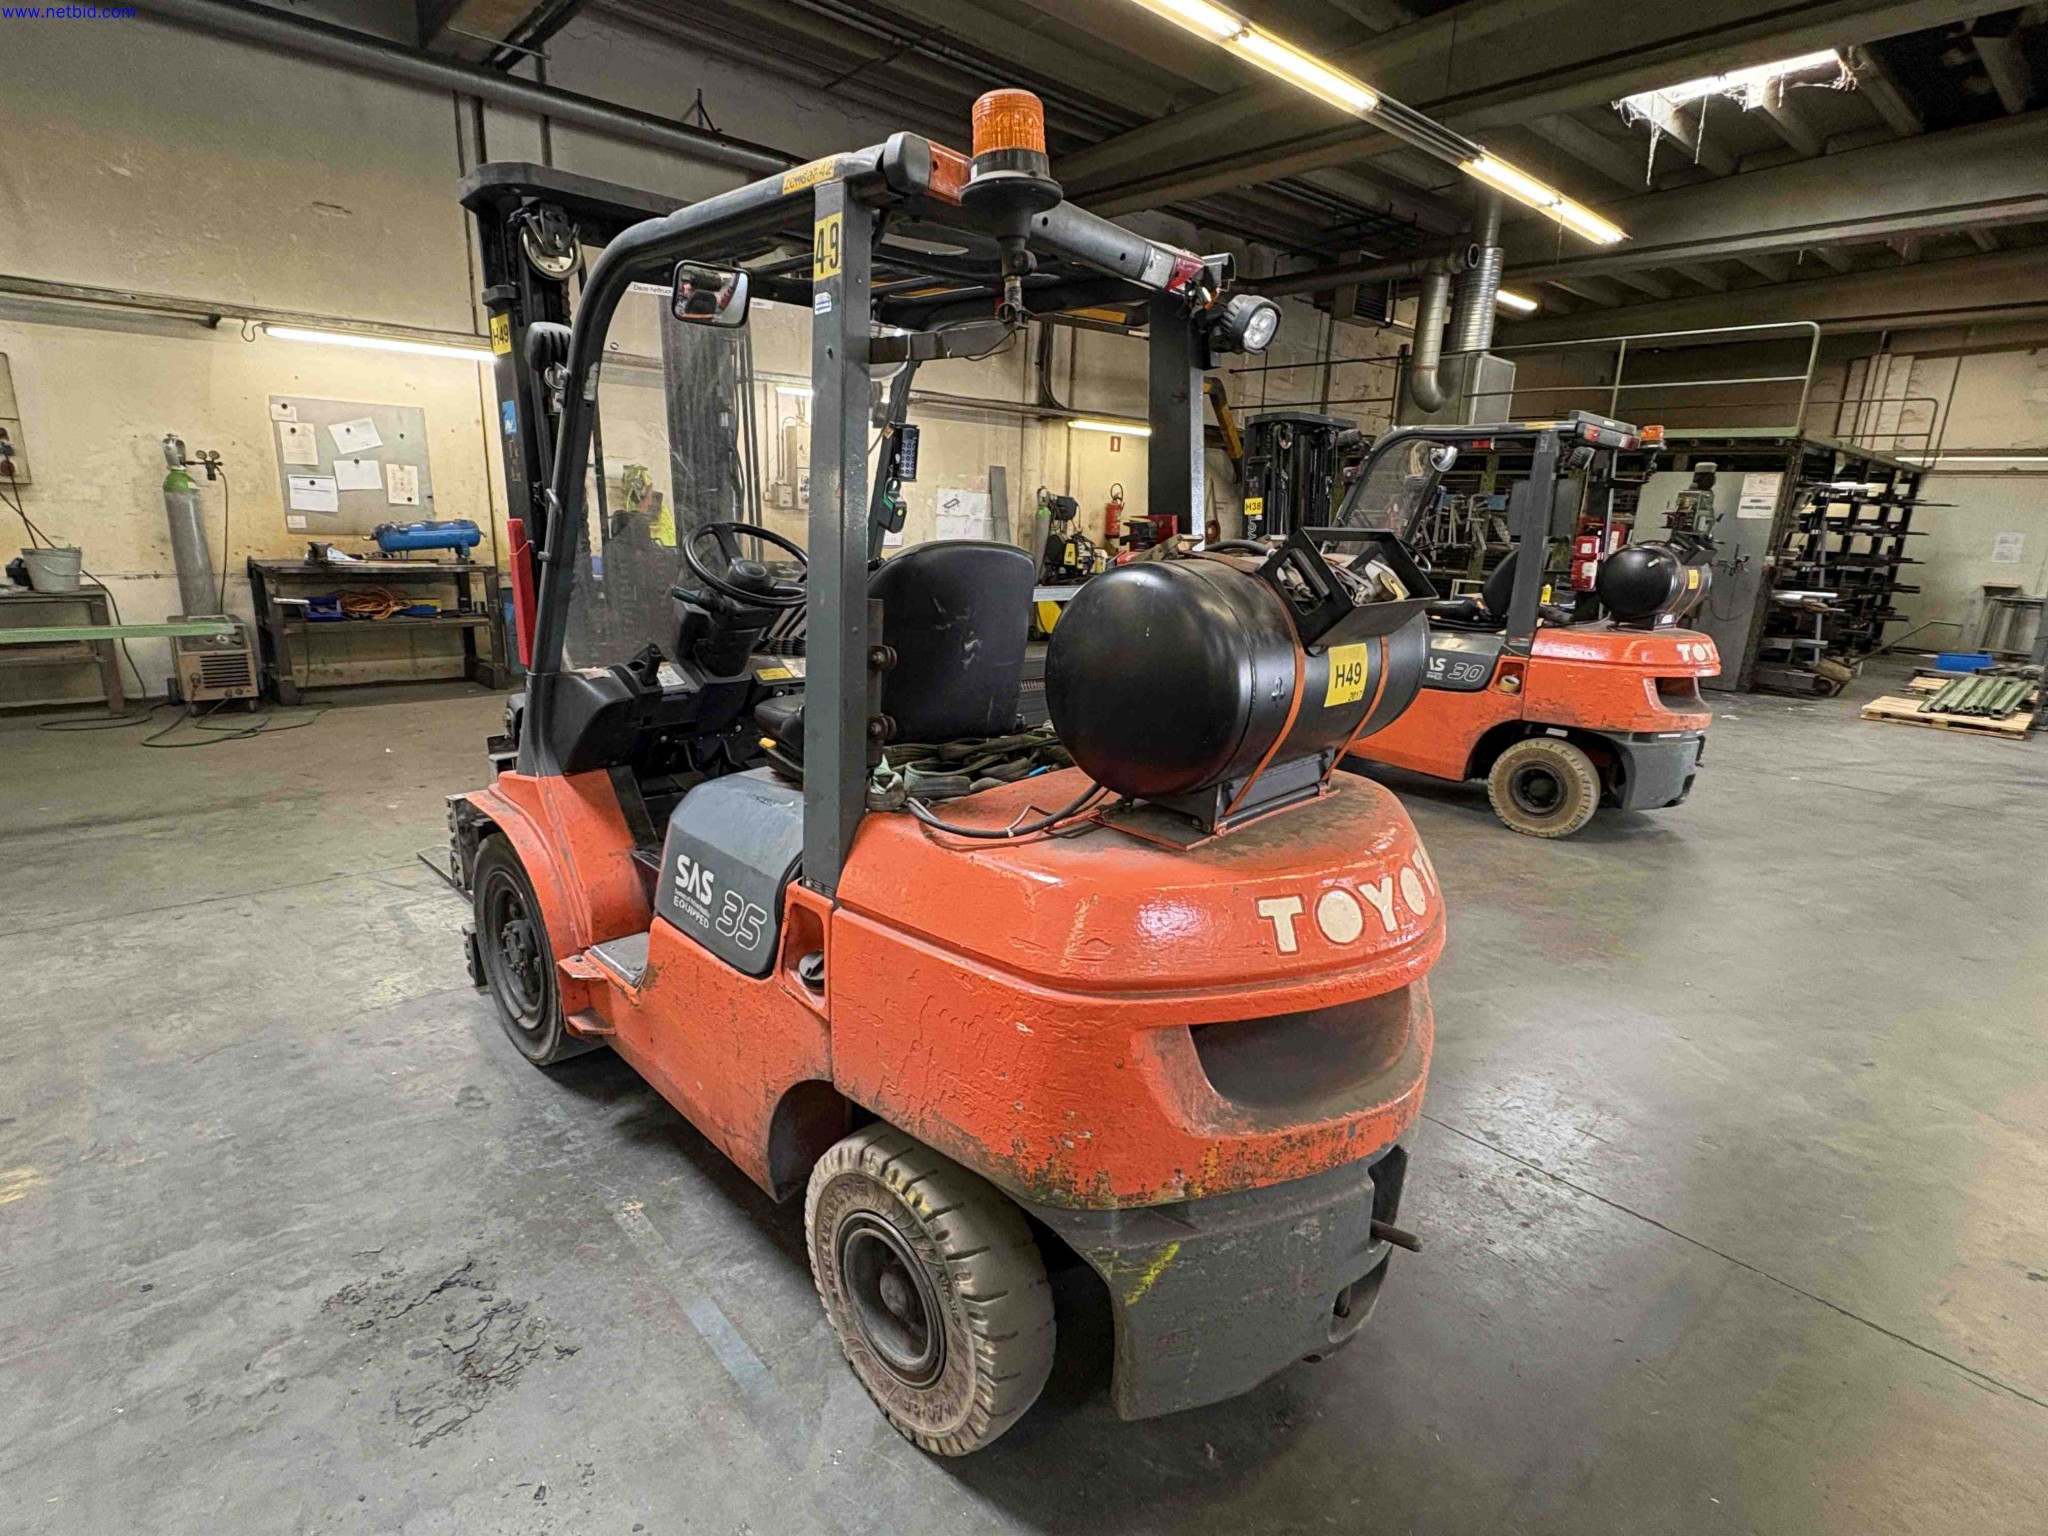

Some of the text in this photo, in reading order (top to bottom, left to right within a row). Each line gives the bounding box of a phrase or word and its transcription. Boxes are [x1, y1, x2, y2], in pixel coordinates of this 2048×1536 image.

[815, 221, 839, 273] 49
[492, 325, 509, 345] H49
[1245, 502, 1261, 511] H38
[1334, 662, 1362, 689] H49
[1447, 662, 1485, 682] 30
[675, 854, 714, 905] SAS
[673, 895, 710, 929] EQUIPPED
[716, 890, 767, 951] 35
